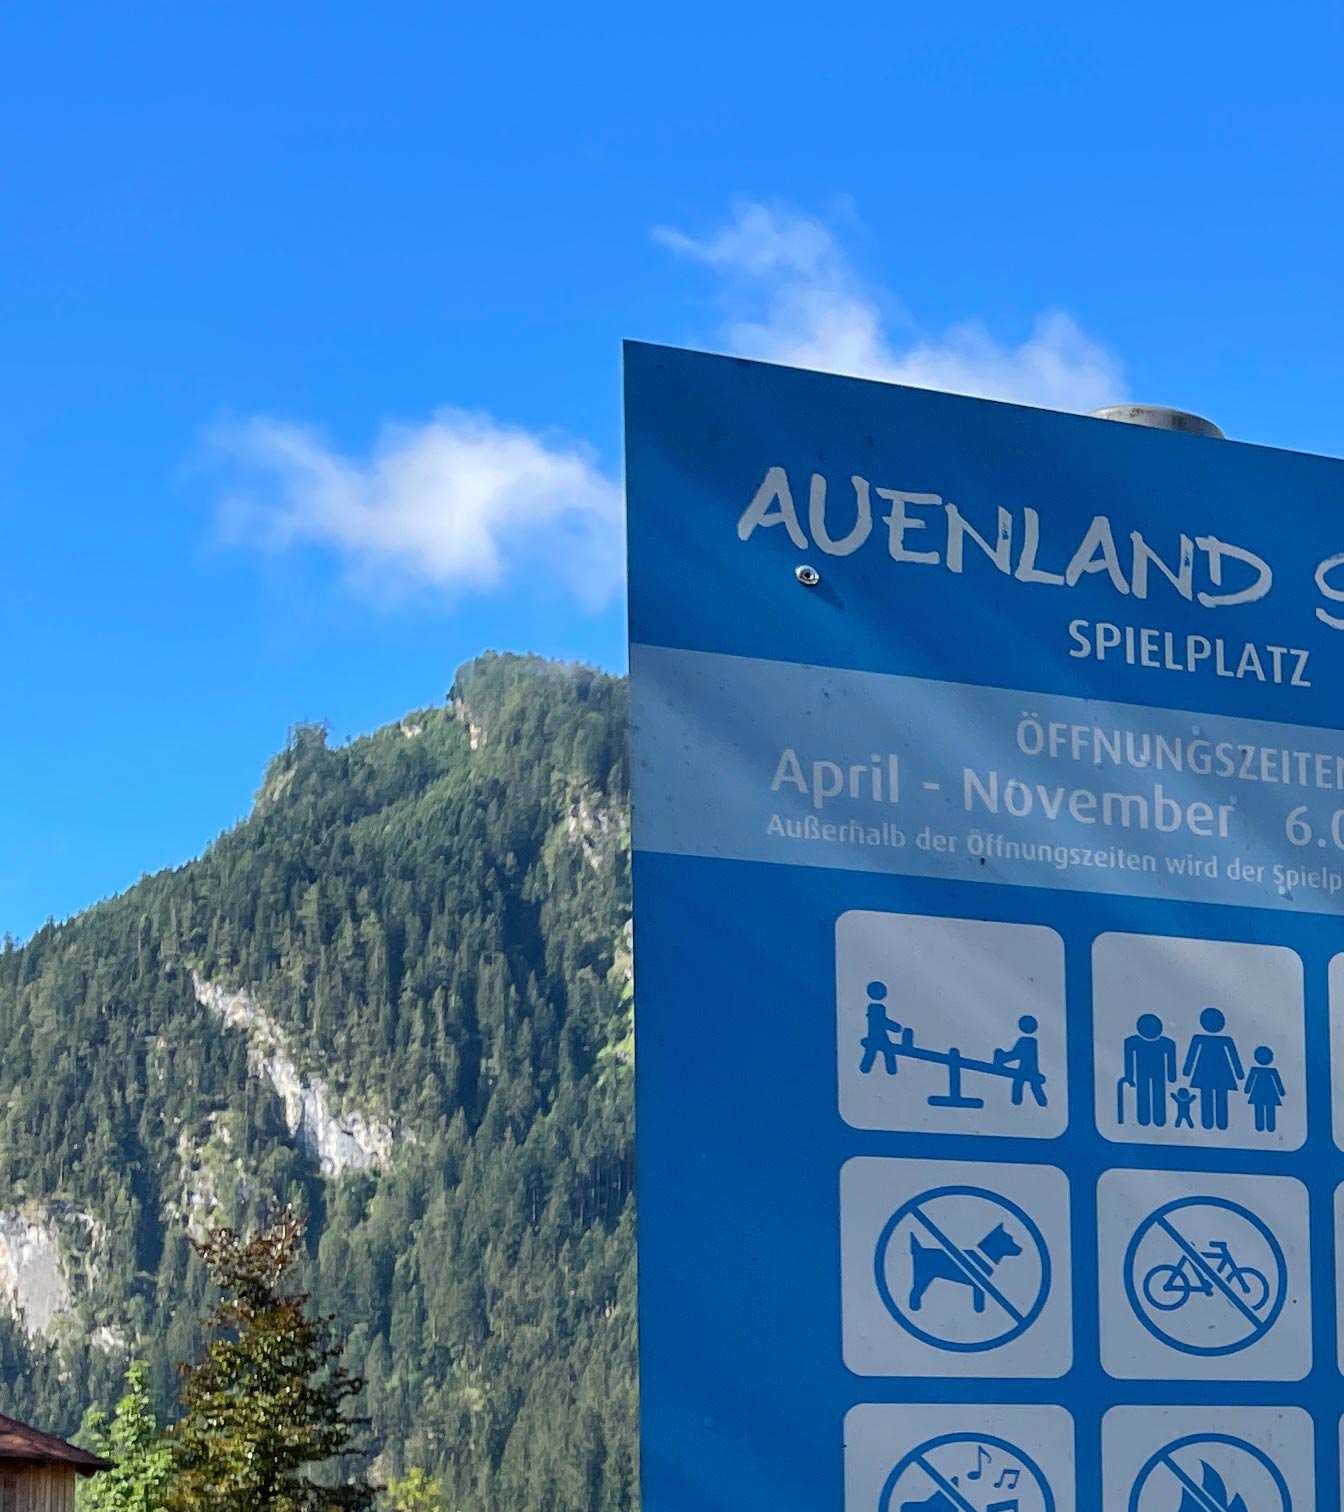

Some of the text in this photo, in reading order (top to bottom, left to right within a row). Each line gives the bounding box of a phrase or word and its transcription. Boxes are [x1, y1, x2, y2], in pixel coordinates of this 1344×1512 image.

[737, 466, 1273, 608] AUENLAND
[1068, 619, 1312, 688] SPIELPLATZ
[770, 748, 900, 809] April
[962, 767, 1235, 839] November
[766, 813, 907, 849] Außerhalb
[915, 825, 958, 854] der
[967, 828, 1157, 873] Öffnungszeiten
[1164, 854, 1218, 879] wird
[1226, 857, 1265, 883] der
